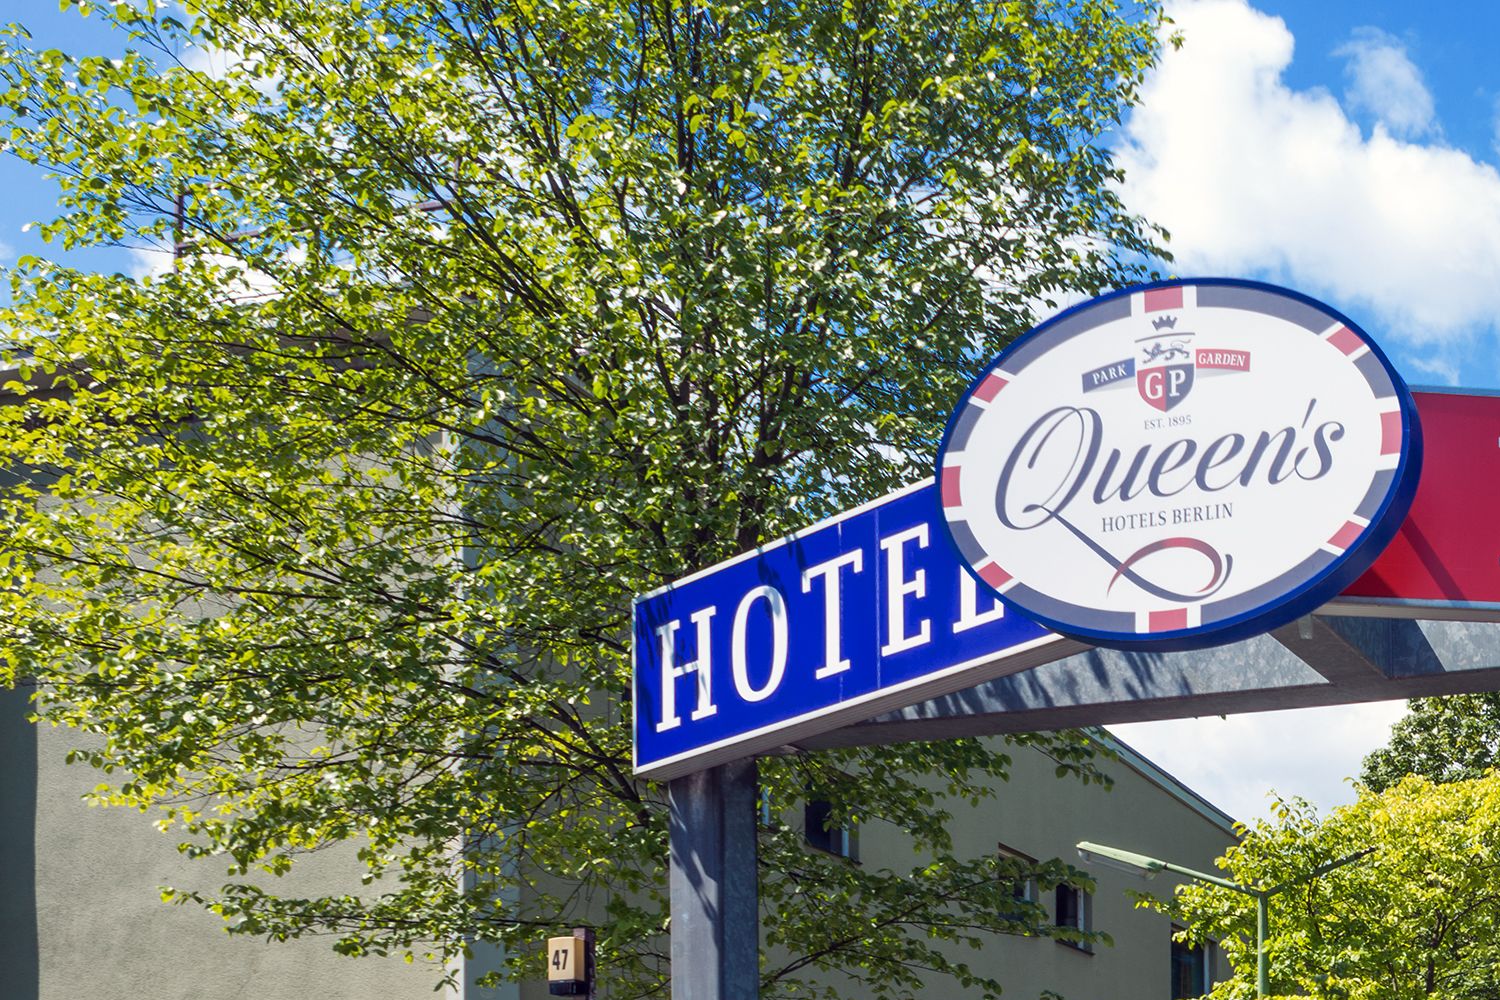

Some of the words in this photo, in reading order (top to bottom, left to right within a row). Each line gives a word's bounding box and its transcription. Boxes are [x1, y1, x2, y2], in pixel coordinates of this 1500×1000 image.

[1198, 352, 1246, 367] GARDEN
[1092, 364, 1128, 385] PARK
[1144, 418, 1165, 430] EST.
[1168, 415, 1192, 427] 1895
[995, 398, 1345, 602] Queen's
[1102, 510, 1167, 532] HOTELS
[1172, 502, 1233, 524] BERLIN
[552, 949, 569, 970] 47
